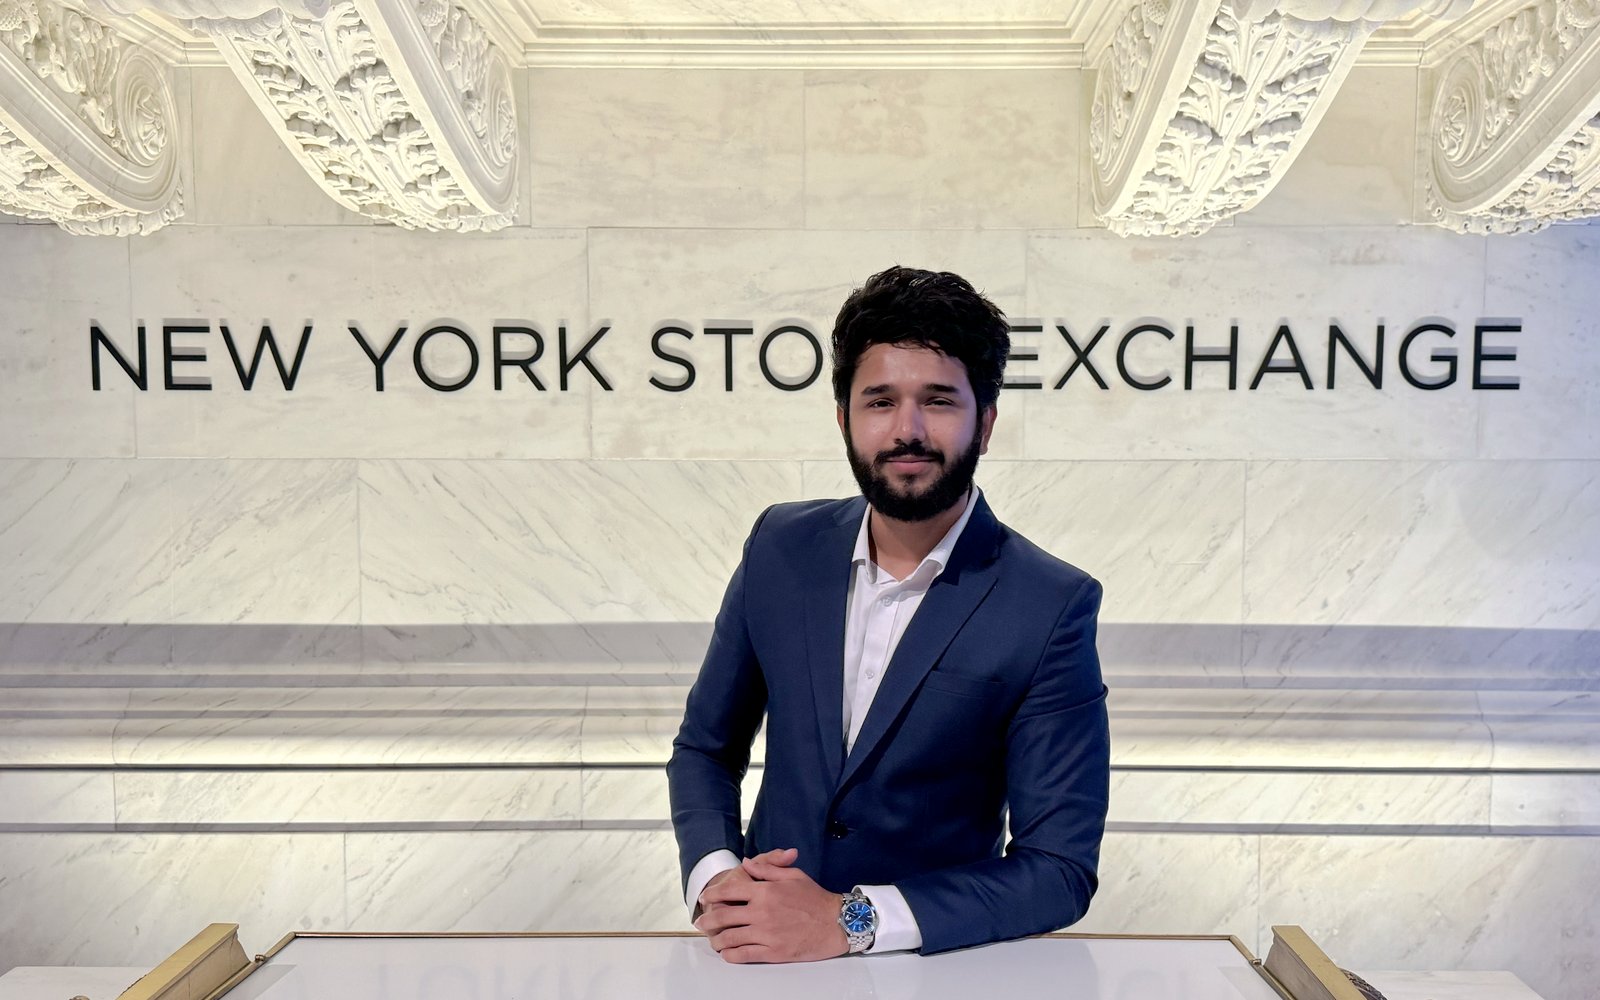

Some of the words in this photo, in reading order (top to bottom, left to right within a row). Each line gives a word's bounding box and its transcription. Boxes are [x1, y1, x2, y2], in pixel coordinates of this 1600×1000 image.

[89, 325, 312, 391] NEW
[347, 325, 613, 391] YORK
[649, 325, 824, 392] STO
[1002, 324, 1522, 391] EXCHANGE
